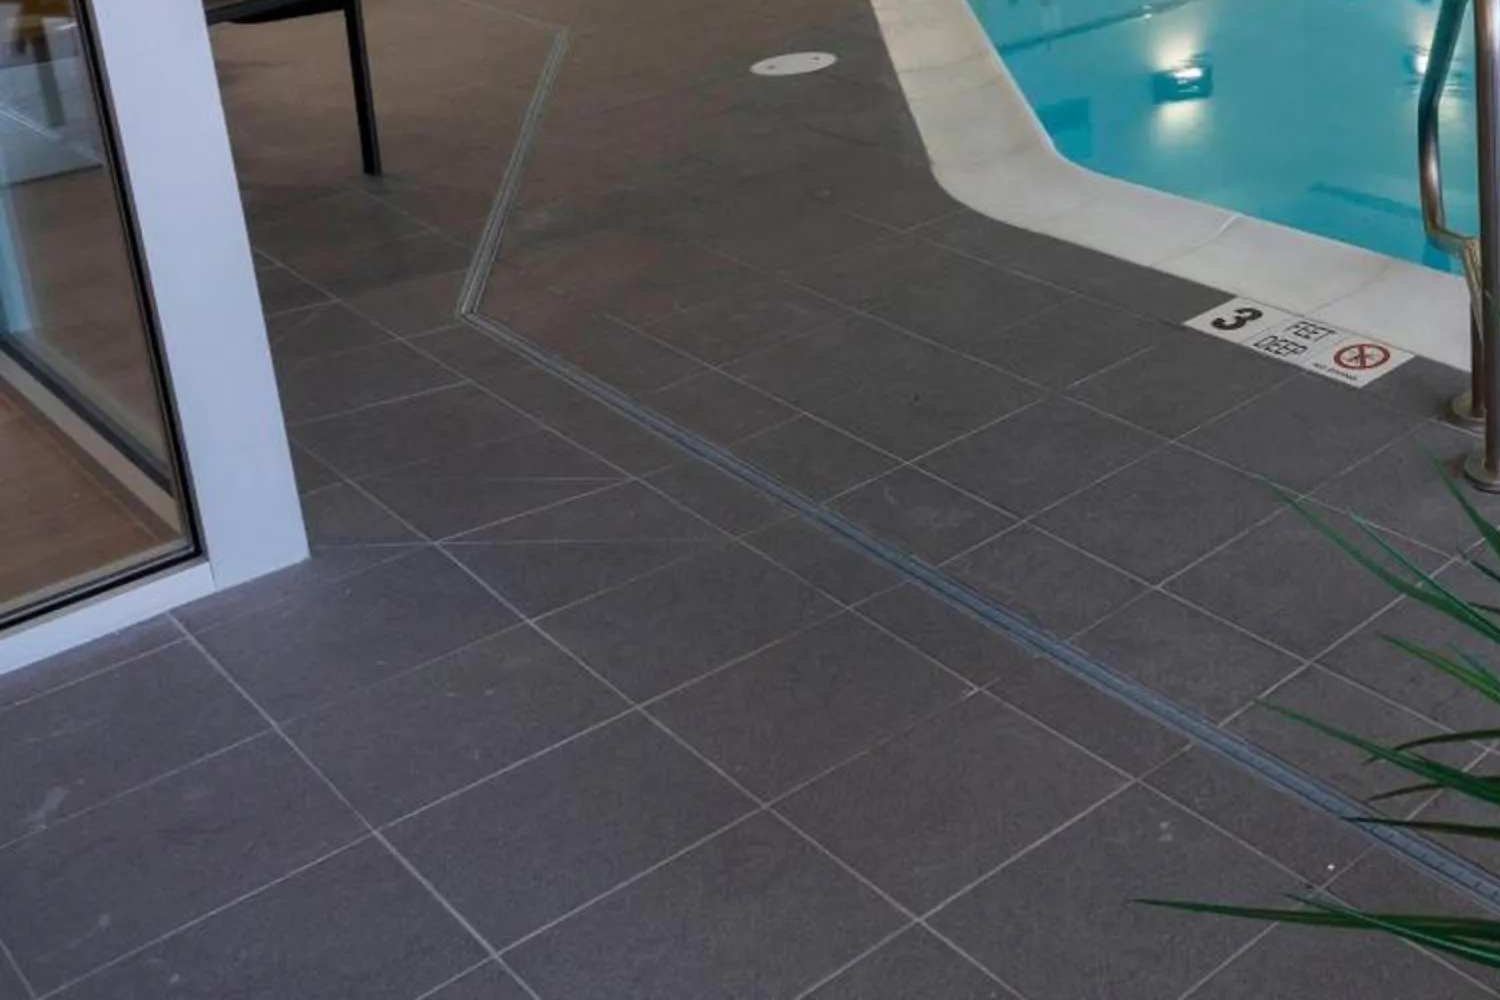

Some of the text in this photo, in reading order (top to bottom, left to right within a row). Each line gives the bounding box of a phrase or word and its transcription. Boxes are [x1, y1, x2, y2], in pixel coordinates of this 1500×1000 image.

[1210, 307, 1263, 330] 3
[1283, 321, 1337, 342] FEET
[1253, 335, 1307, 357] DEEP
